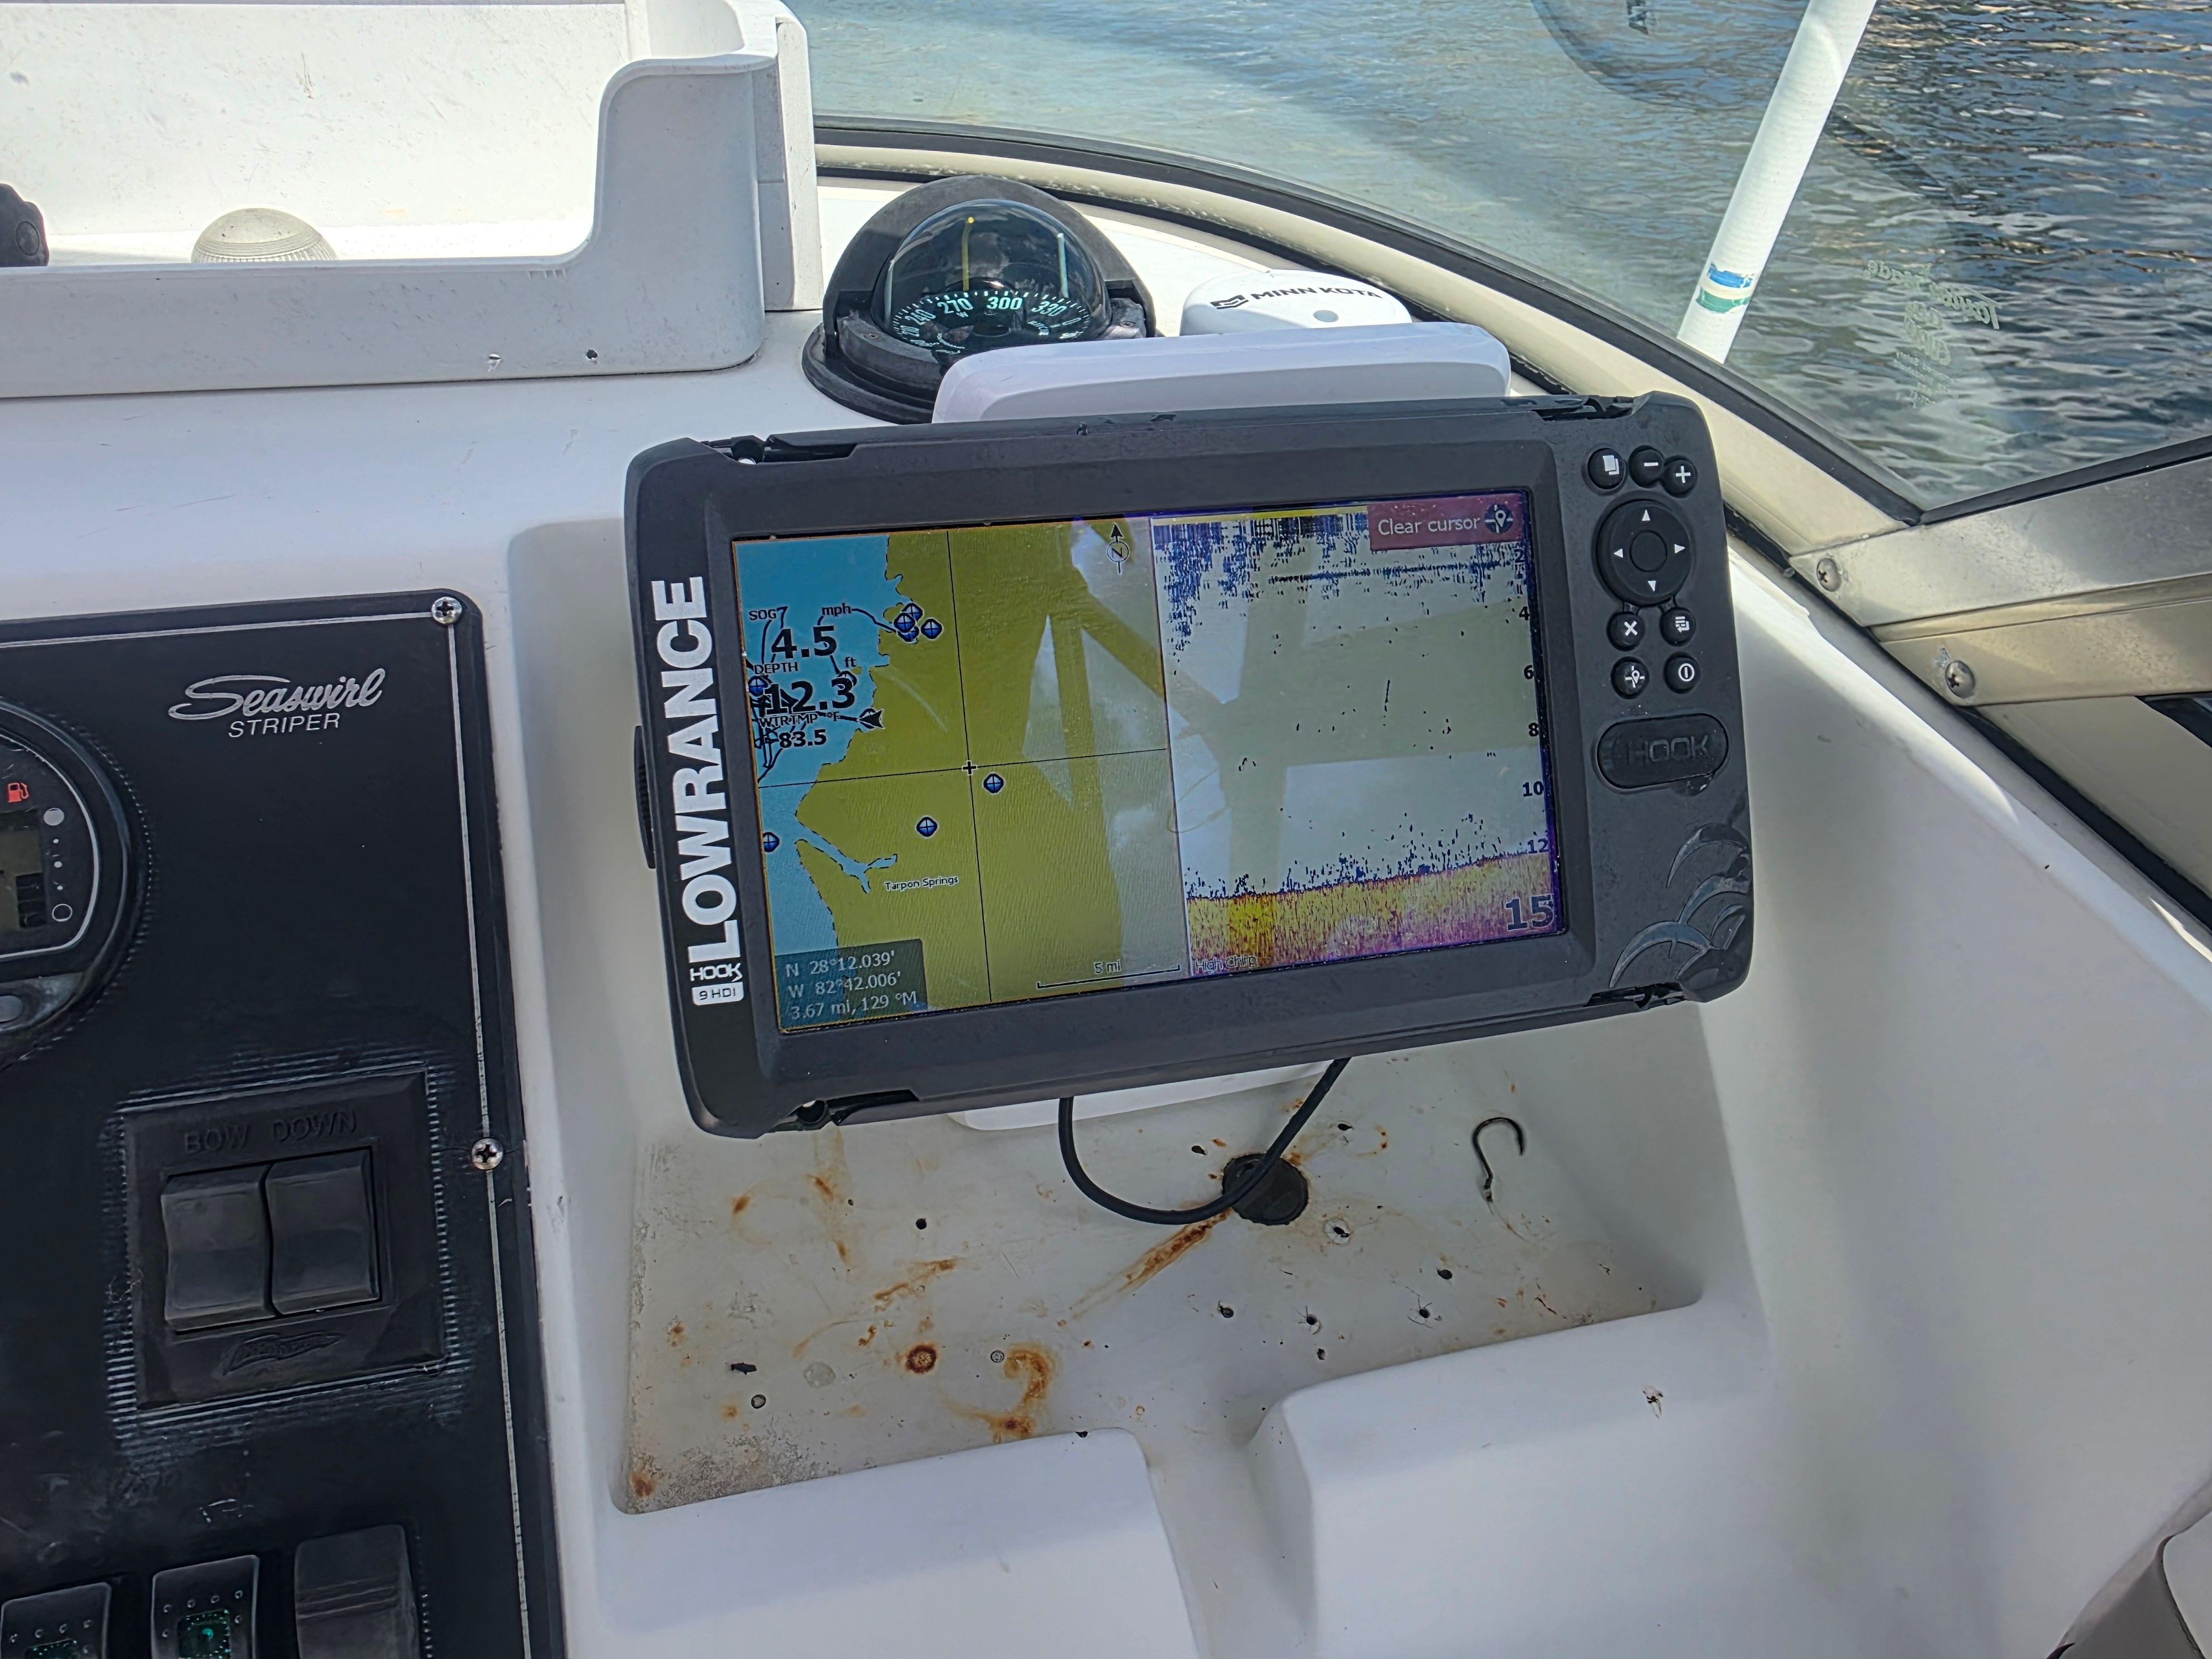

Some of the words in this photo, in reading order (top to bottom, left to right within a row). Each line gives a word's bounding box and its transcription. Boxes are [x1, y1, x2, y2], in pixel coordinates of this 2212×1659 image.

[1250, 288, 1318, 300] MINN
[1319, 287, 1384, 299] KOTA
[937, 298, 973, 314] 270
[987, 297, 1023, 310] 300
[1031, 301, 1067, 318] 330
[904, 309, 936, 325] 240
[1378, 518, 1422, 535] Clear
[1428, 517, 1481, 532] cursor
[748, 609, 776, 620] SOG
[822, 602, 852, 617] mph
[1519, 606, 1530, 620] 4
[771, 625, 837, 659] 4.5
[754, 661, 799, 675] DEPTH
[844, 656, 857, 667] ft
[1524, 665, 1535, 680] 6
[168, 668, 386, 720] Seaswirl
[764, 677, 855, 715] 12.3
[228, 712, 341, 738] STRIPER
[1528, 723, 1540, 737] 8
[779, 729, 827, 748] 83.5
[1627, 735, 1710, 766] HOOK
[651, 576, 742, 963] LOWRANCE
[1522, 781, 1544, 797] 10
[1527, 838, 1549, 854] 12
[885, 881, 920, 891] Tarpon
[922, 876, 958, 888] Springs
[1505, 893, 1554, 931] 15
[690, 963, 743, 982] HOOK
[786, 963, 799, 977] N
[810, 950, 895, 974] 28°12.039'
[1094, 962, 1103, 974] 5
[1107, 959, 1120, 972] mi
[1196, 959, 1222, 974] High
[1225, 954, 1256, 969] Chirp
[787, 984, 804, 998] W
[815, 971, 901, 995] 82°42.006'
[699, 990, 708, 1000] 9
[711, 988, 736, 999] HDI
[791, 1003, 825, 1020] 3.67
[831, 1000, 857, 1015] mi,
[862, 994, 889, 1011] 129
[184, 1123, 252, 1155] BOW
[272, 1110, 358, 1142] DOWN
